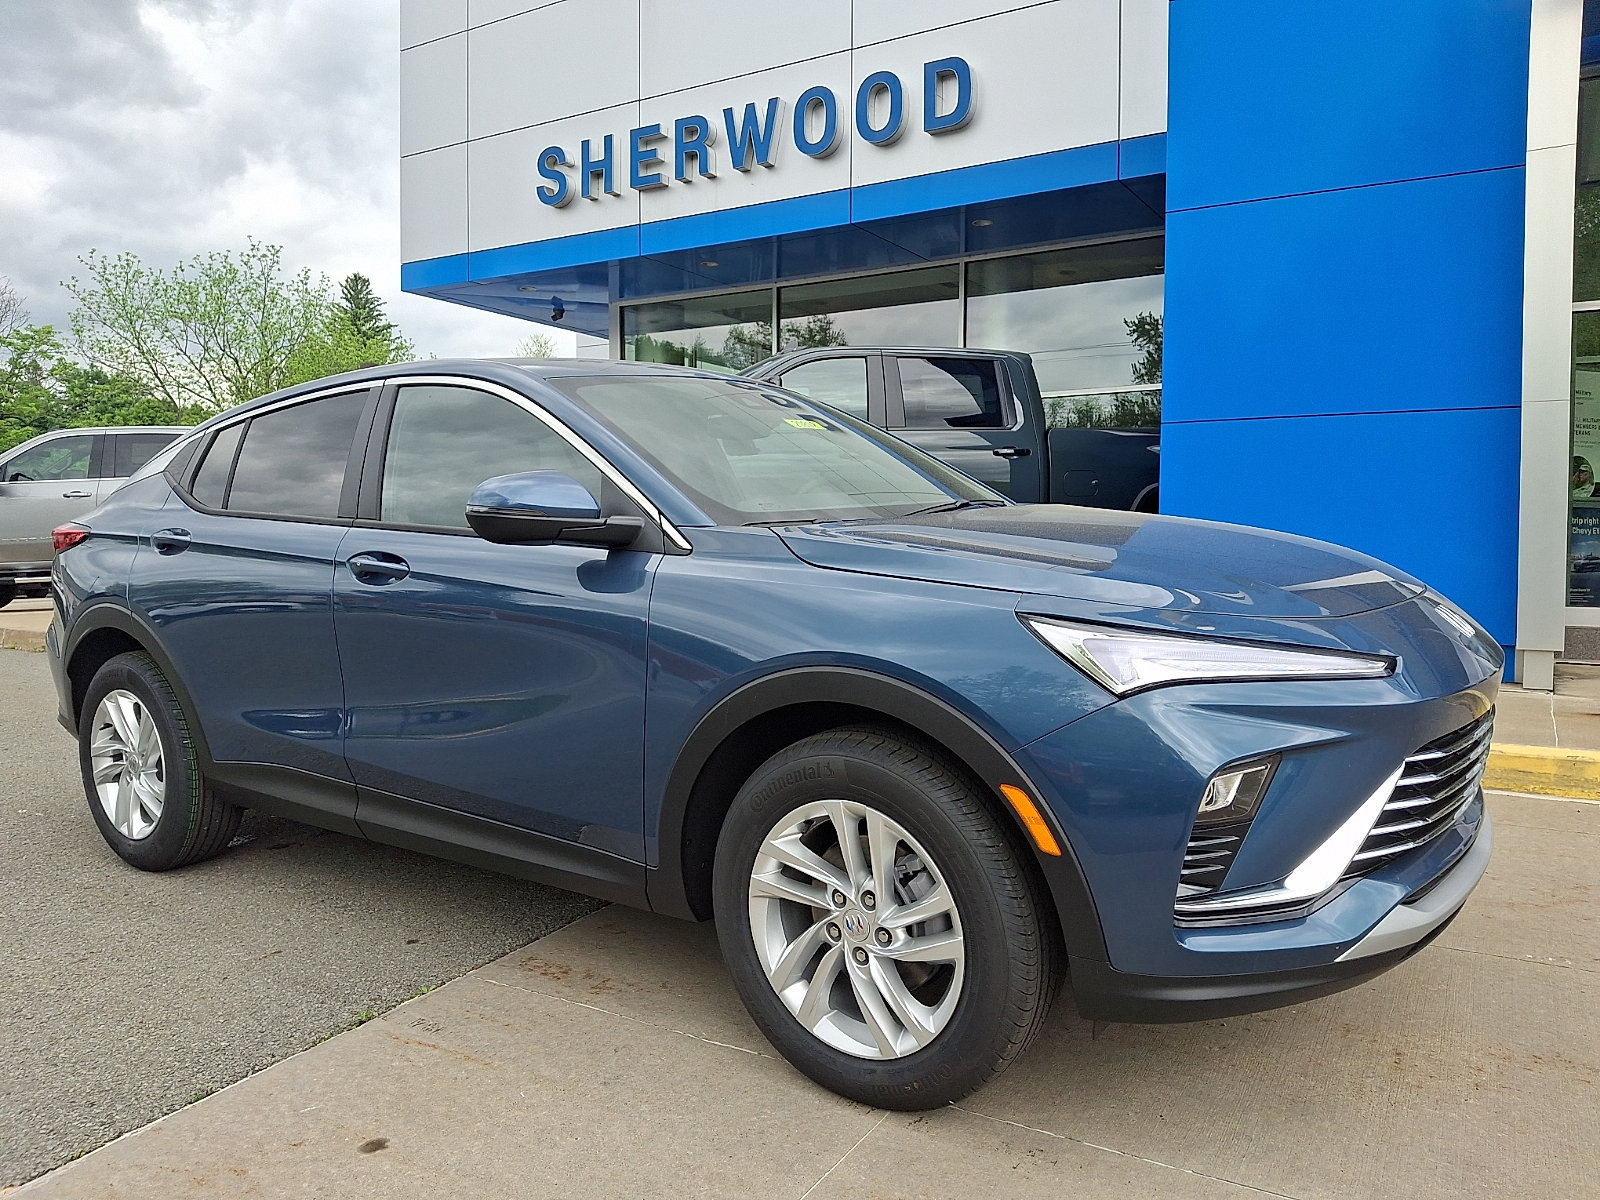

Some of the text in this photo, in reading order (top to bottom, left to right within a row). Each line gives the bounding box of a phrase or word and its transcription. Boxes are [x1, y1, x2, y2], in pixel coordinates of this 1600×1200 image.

[536, 56, 976, 208] SHERWOOD
[1572, 517, 1599, 526] trip right
[1572, 526, 1591, 536] Chevy
[750, 762, 821, 813] Continental
